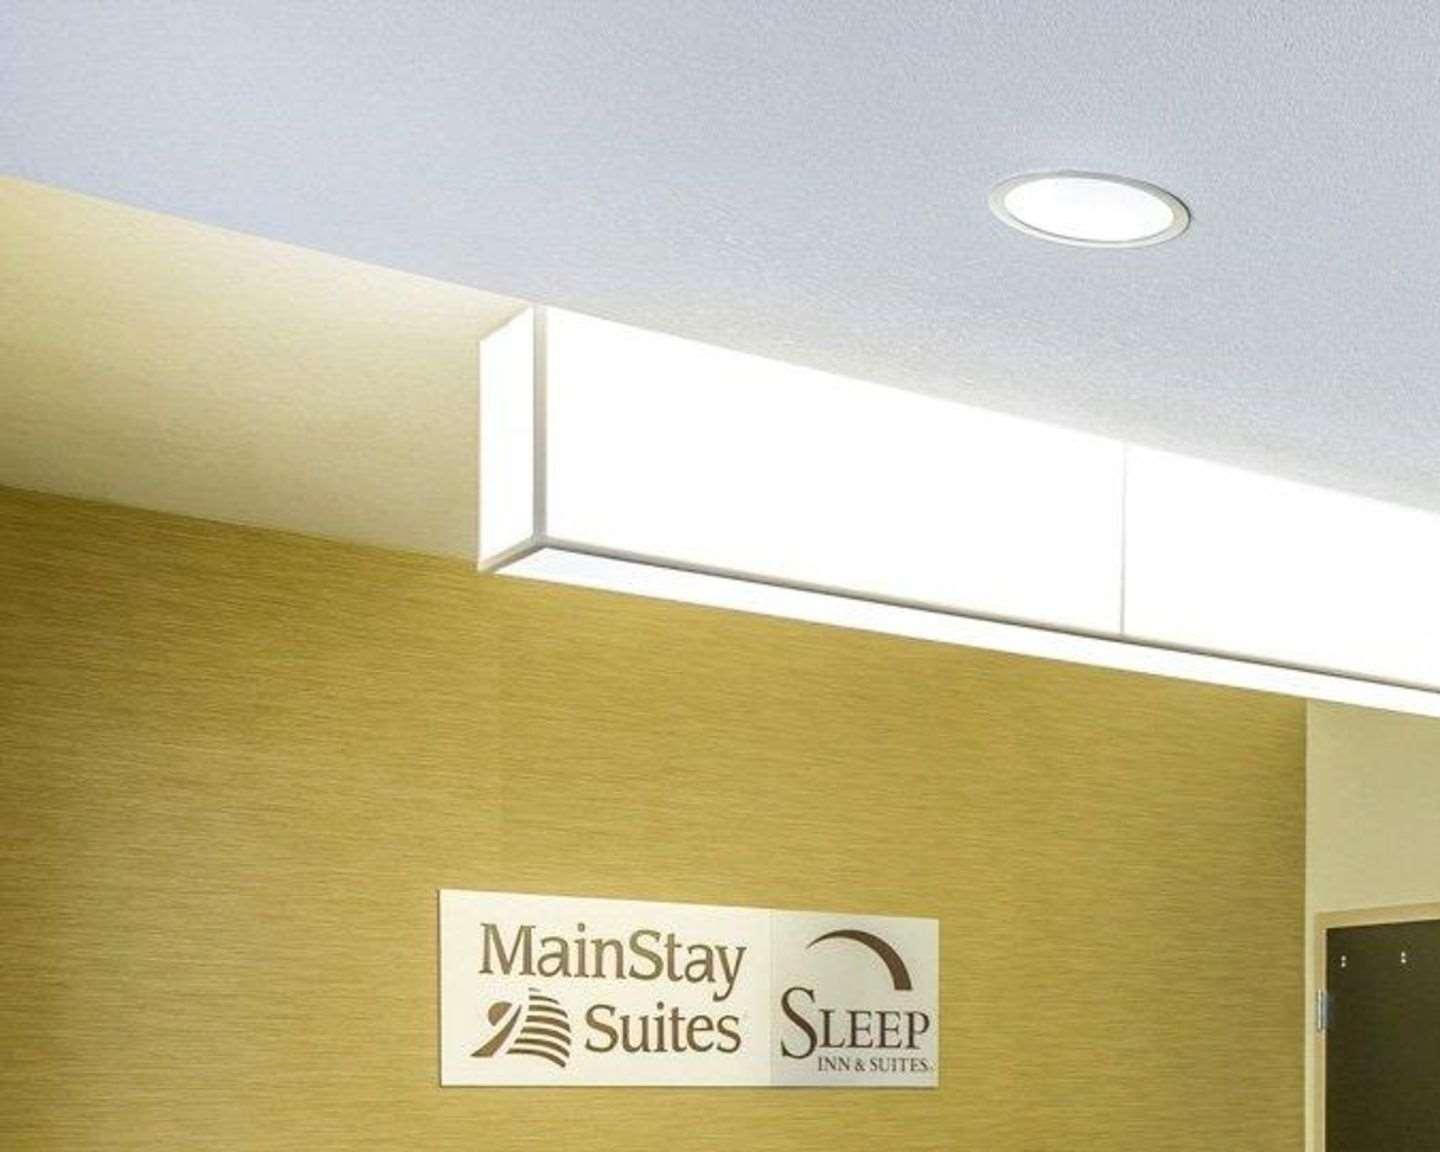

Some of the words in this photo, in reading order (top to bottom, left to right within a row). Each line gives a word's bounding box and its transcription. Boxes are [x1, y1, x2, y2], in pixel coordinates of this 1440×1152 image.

[479, 921, 747, 1001] MainStay
[585, 1002, 742, 1054] Suites
[780, 986, 931, 1060] SLEEP
[817, 1056, 851, 1072] INN
[855, 1057, 866, 1072] &
